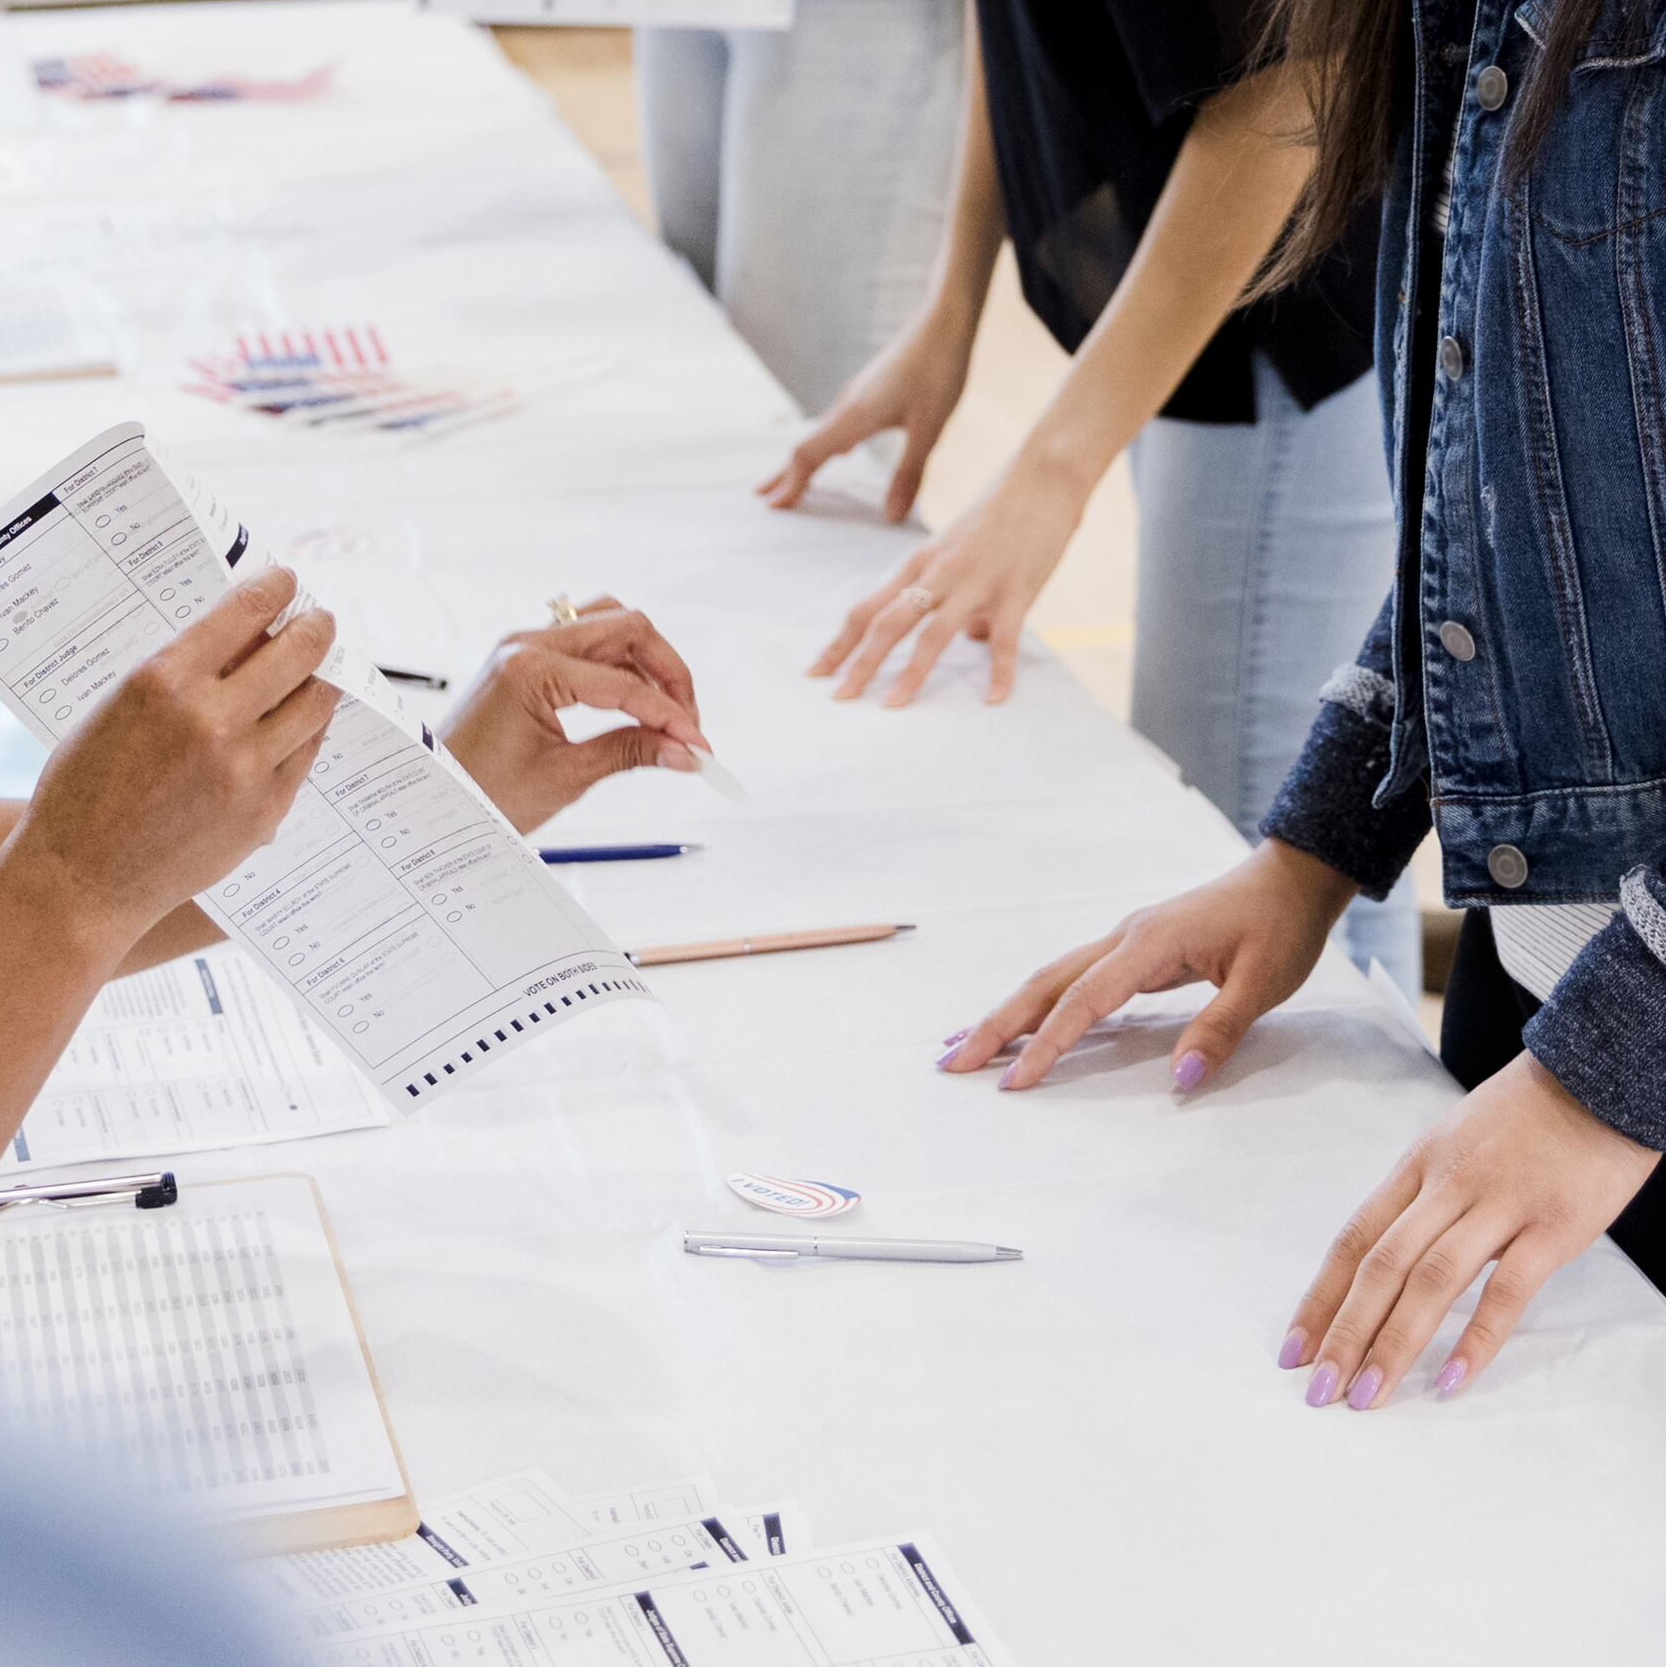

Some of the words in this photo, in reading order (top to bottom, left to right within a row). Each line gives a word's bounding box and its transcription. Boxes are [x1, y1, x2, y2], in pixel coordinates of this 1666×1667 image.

[63, 484, 75, 493] For
[73, 469, 95, 486] District
[115, 505, 127, 513] Yes
[9, 516, 32, 535] Offices
[129, 523, 141, 531] No
[128, 557, 140, 567] For
[138, 543, 160, 560] District
[7, 563, 33, 583] Gomez
[179, 578, 192, 587] Yes
[12, 587, 39, 607] Mackey
[194, 597, 205, 605] No
[12, 617, 35, 635] Benito
[33, 598, 60, 618] Chavez
[23, 677, 37, 688] For
[34, 659, 59, 680] District
[59, 645, 79, 662] Judge
[61, 665, 88, 686] Delores
[85, 648, 110, 667] Gomez
[77, 689, 93, 702] Ivan
[90, 671, 117, 691] Mackey
[333, 753, 343, 761] No
[335, 788, 346, 797] For
[345, 777, 366, 791] District
[385, 811, 397, 819] Yes
[401, 863, 412, 871] For
[411, 852, 432, 866] District
[244, 871, 256, 881] No
[451, 886, 463, 894] Yes
[241, 908, 254, 918] For
[253, 892, 277, 910] District
[294, 924, 309, 934] Yes
[309, 942, 321, 950] No
[306, 976, 318, 986] For
[317, 961, 341, 978] District
[523, 981, 548, 997] VOTE
[545, 975, 559, 986] ON
[557, 968, 579, 981] BOTH
[360, 993, 373, 1003] Yes
[373, 1010, 385, 1019] No
[744, 1182, 812, 1208] VOTED!
[914, 1562, 930, 1581] District
[925, 1580, 937, 1591] and
[931, 1590, 947, 1607] County
[942, 1606, 957, 1624] Offices
